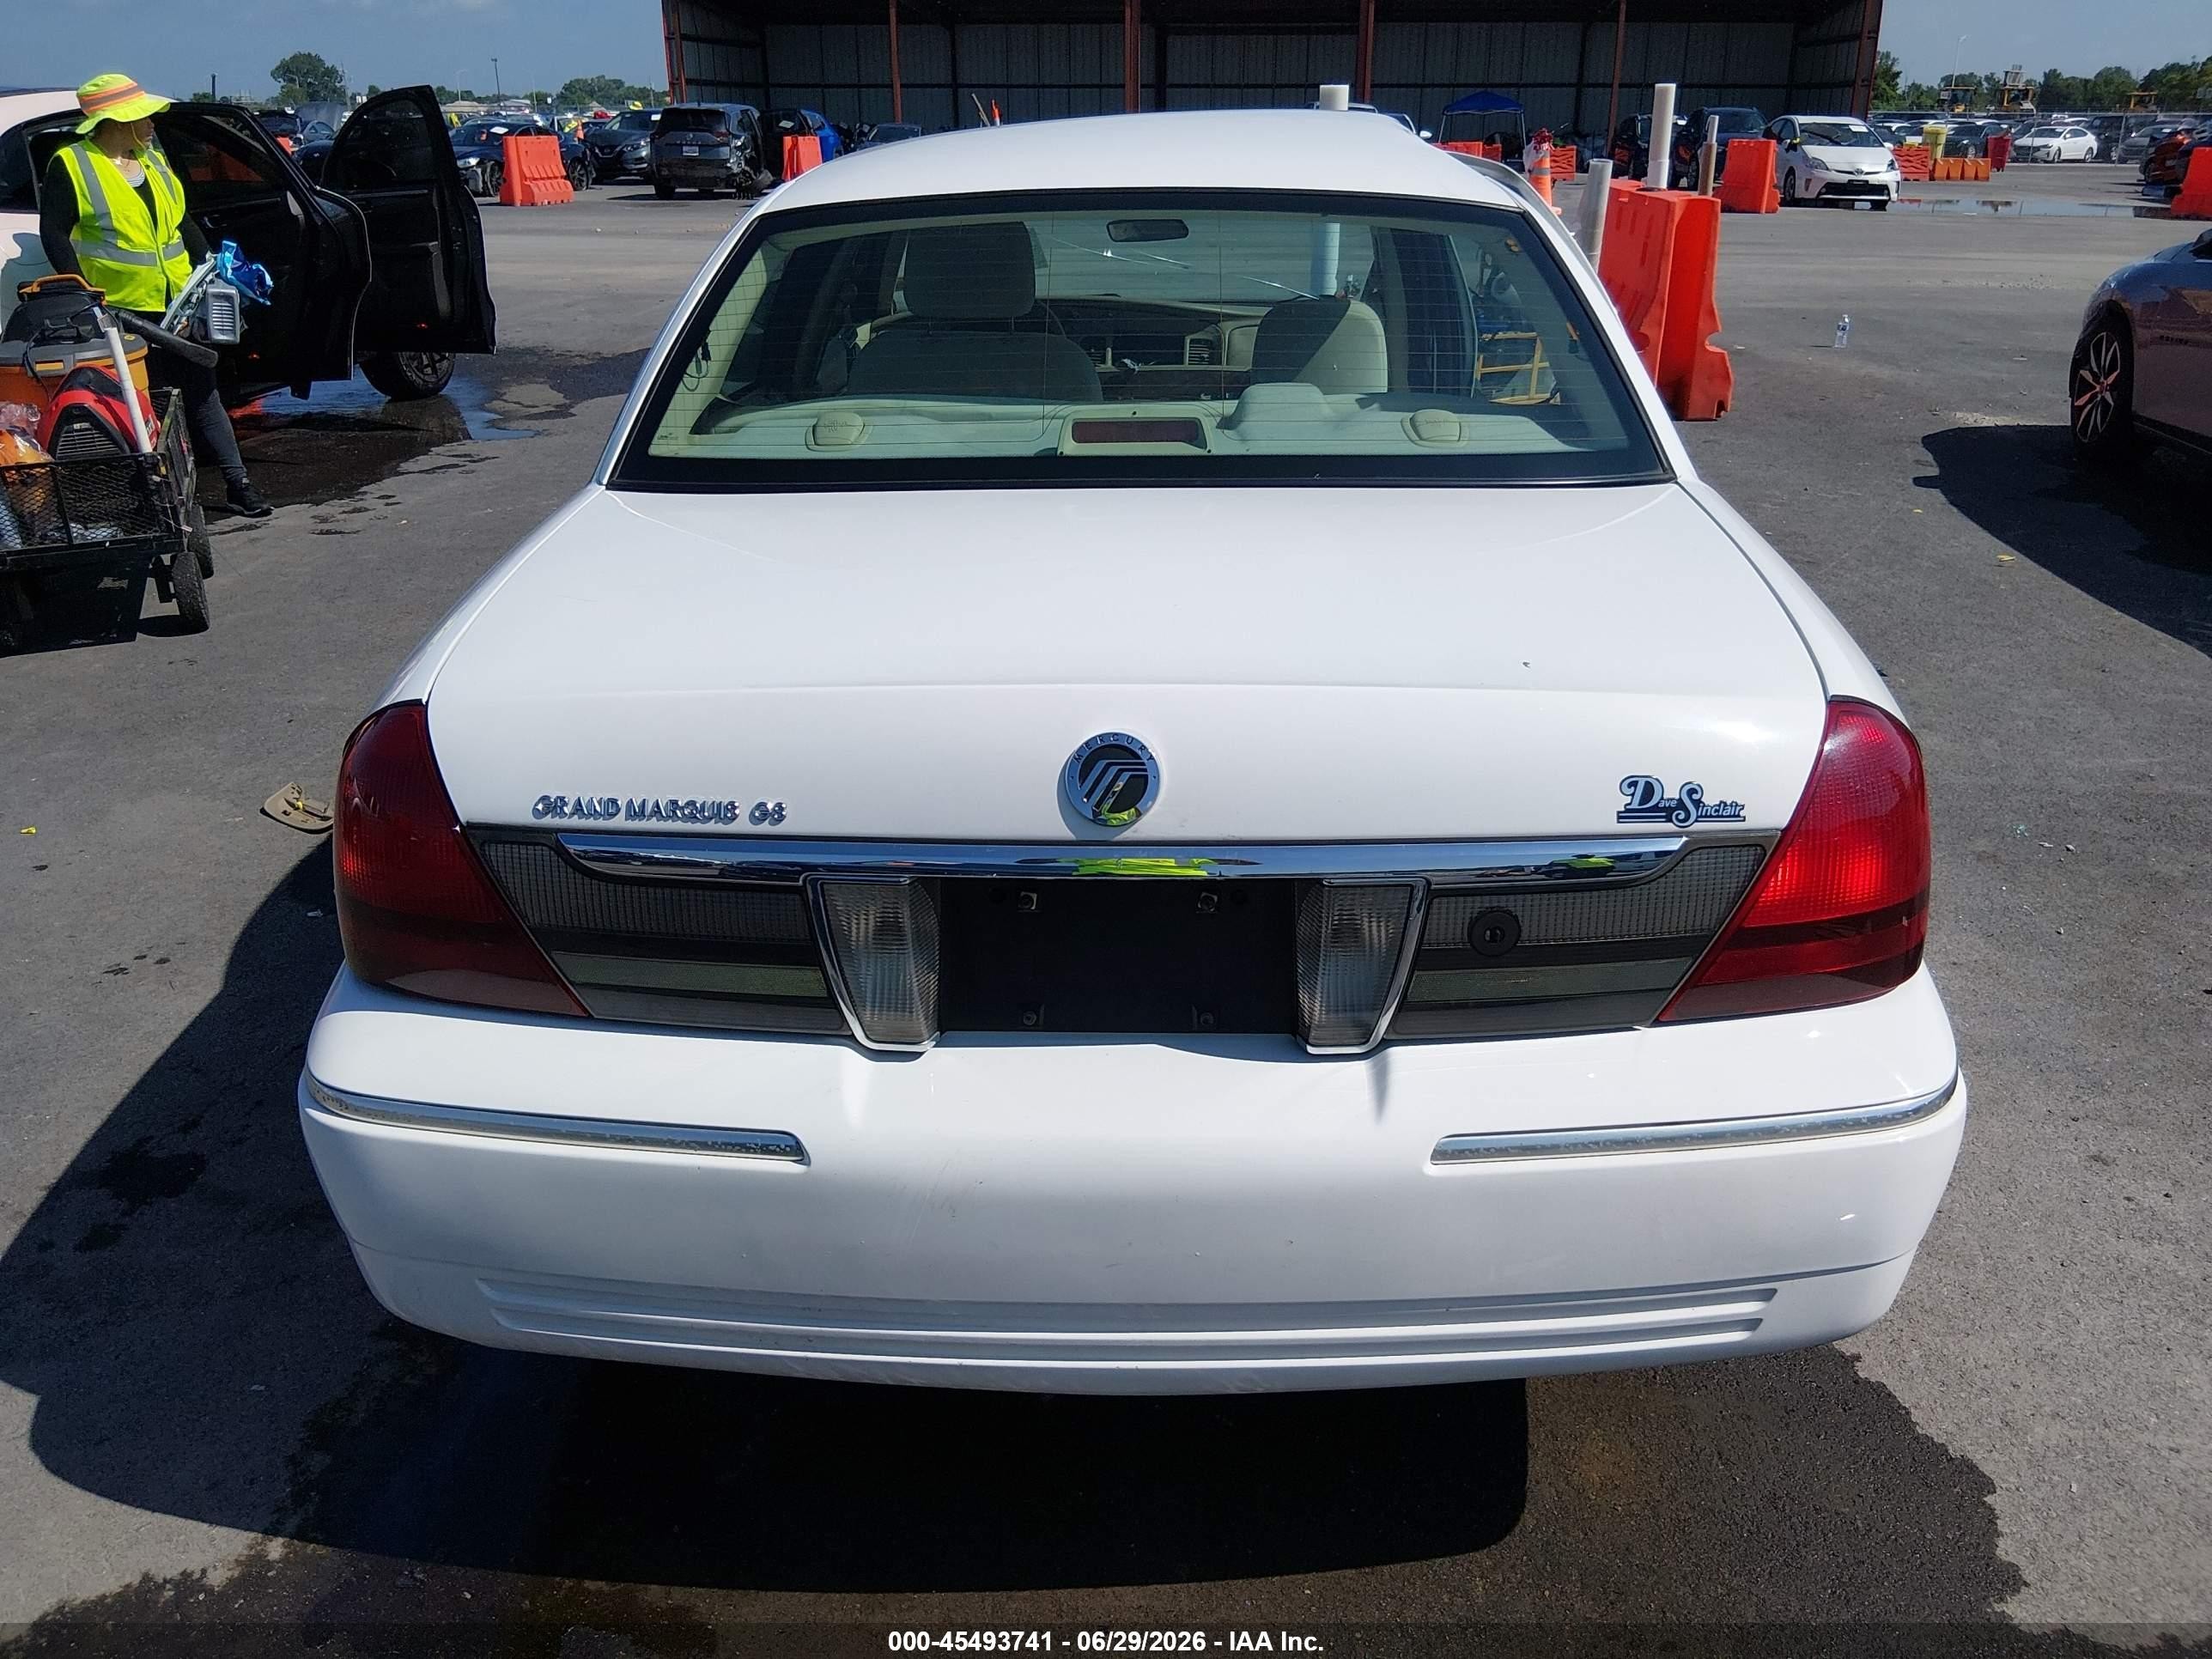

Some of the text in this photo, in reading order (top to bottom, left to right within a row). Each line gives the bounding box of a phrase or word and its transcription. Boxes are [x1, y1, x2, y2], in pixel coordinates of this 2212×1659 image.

[1072, 733, 1155, 764] MERCURY
[533, 795, 787, 824] GRAND MARQUIS GS
[1620, 776, 1744, 827] Dave Sinclair
